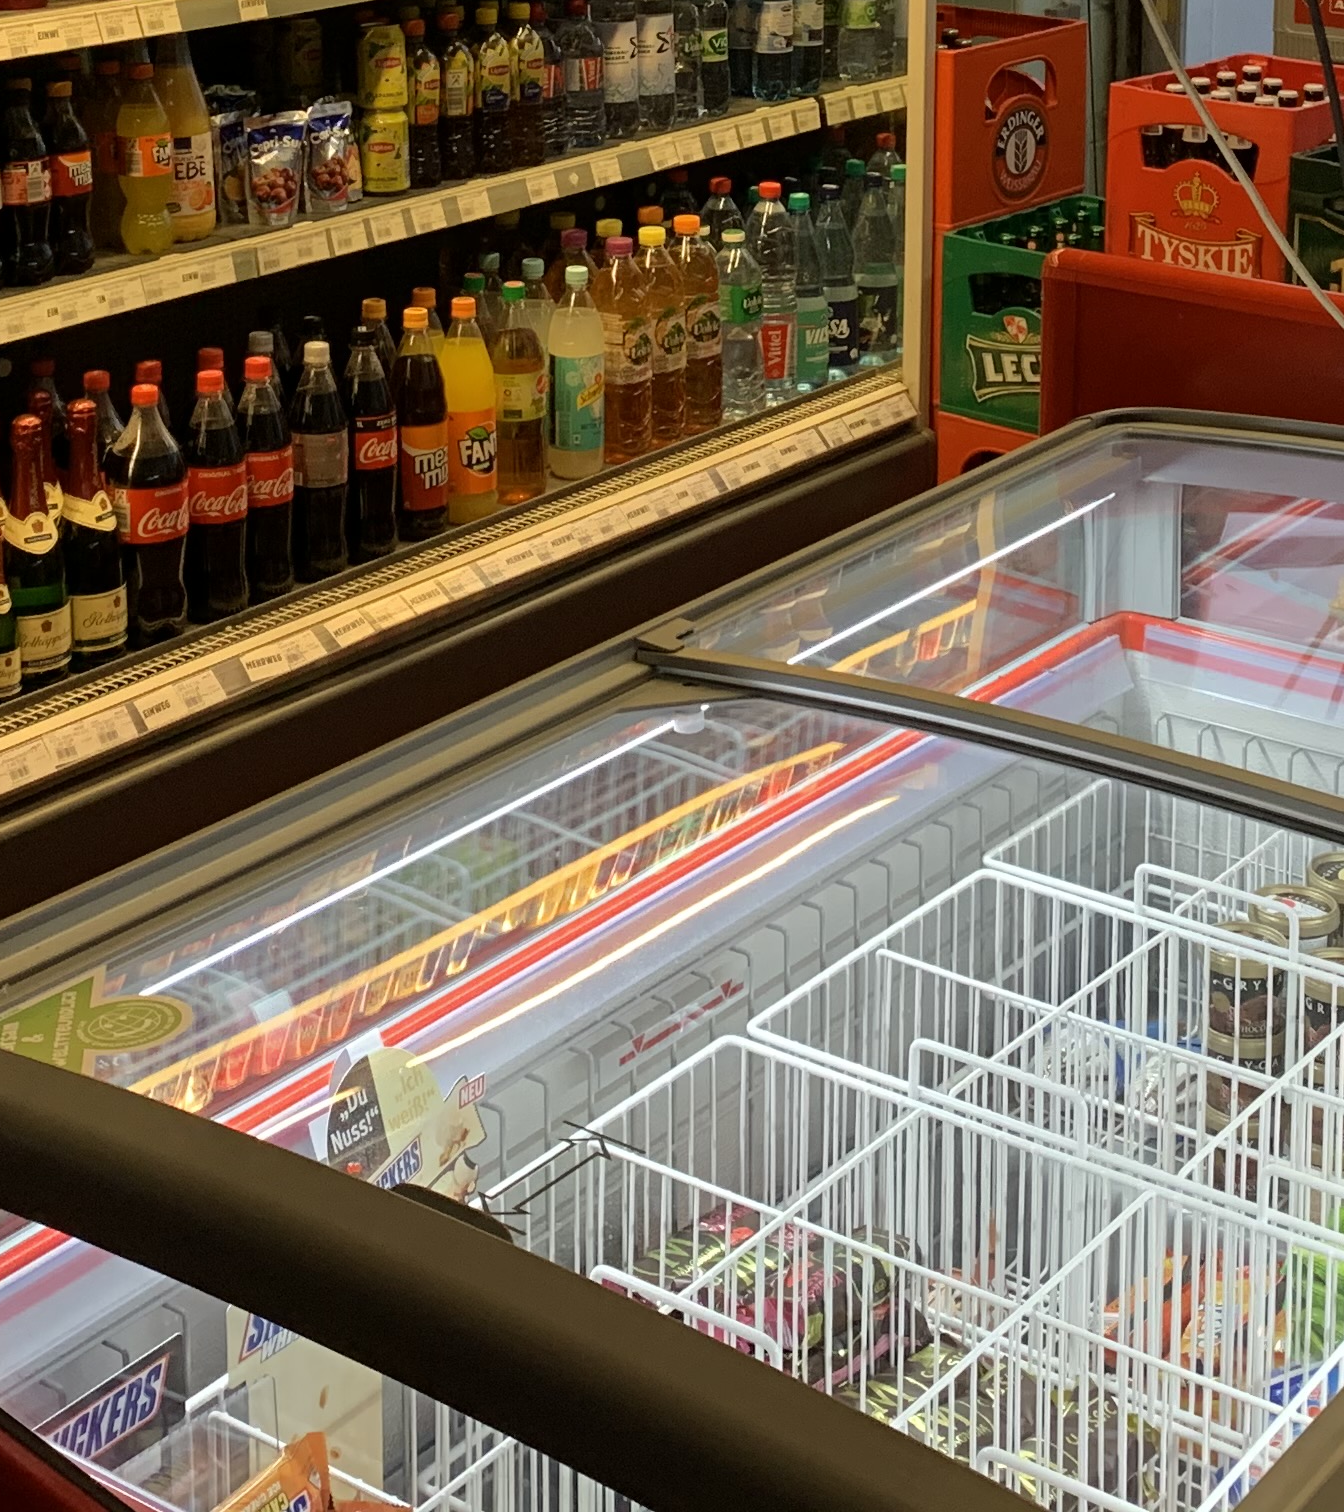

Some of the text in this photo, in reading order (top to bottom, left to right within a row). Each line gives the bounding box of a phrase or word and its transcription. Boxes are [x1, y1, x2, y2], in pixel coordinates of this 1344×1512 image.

[997, 109, 1046, 151] ERDINGER
[1135, 223, 1255, 279] TYSKIE
[332, 616, 365, 639] MEHRWEG
[245, 652, 283, 672] MEHRWEG
[142, 698, 171, 719] EINWEG
[460, 1077, 484, 1107] NEU
